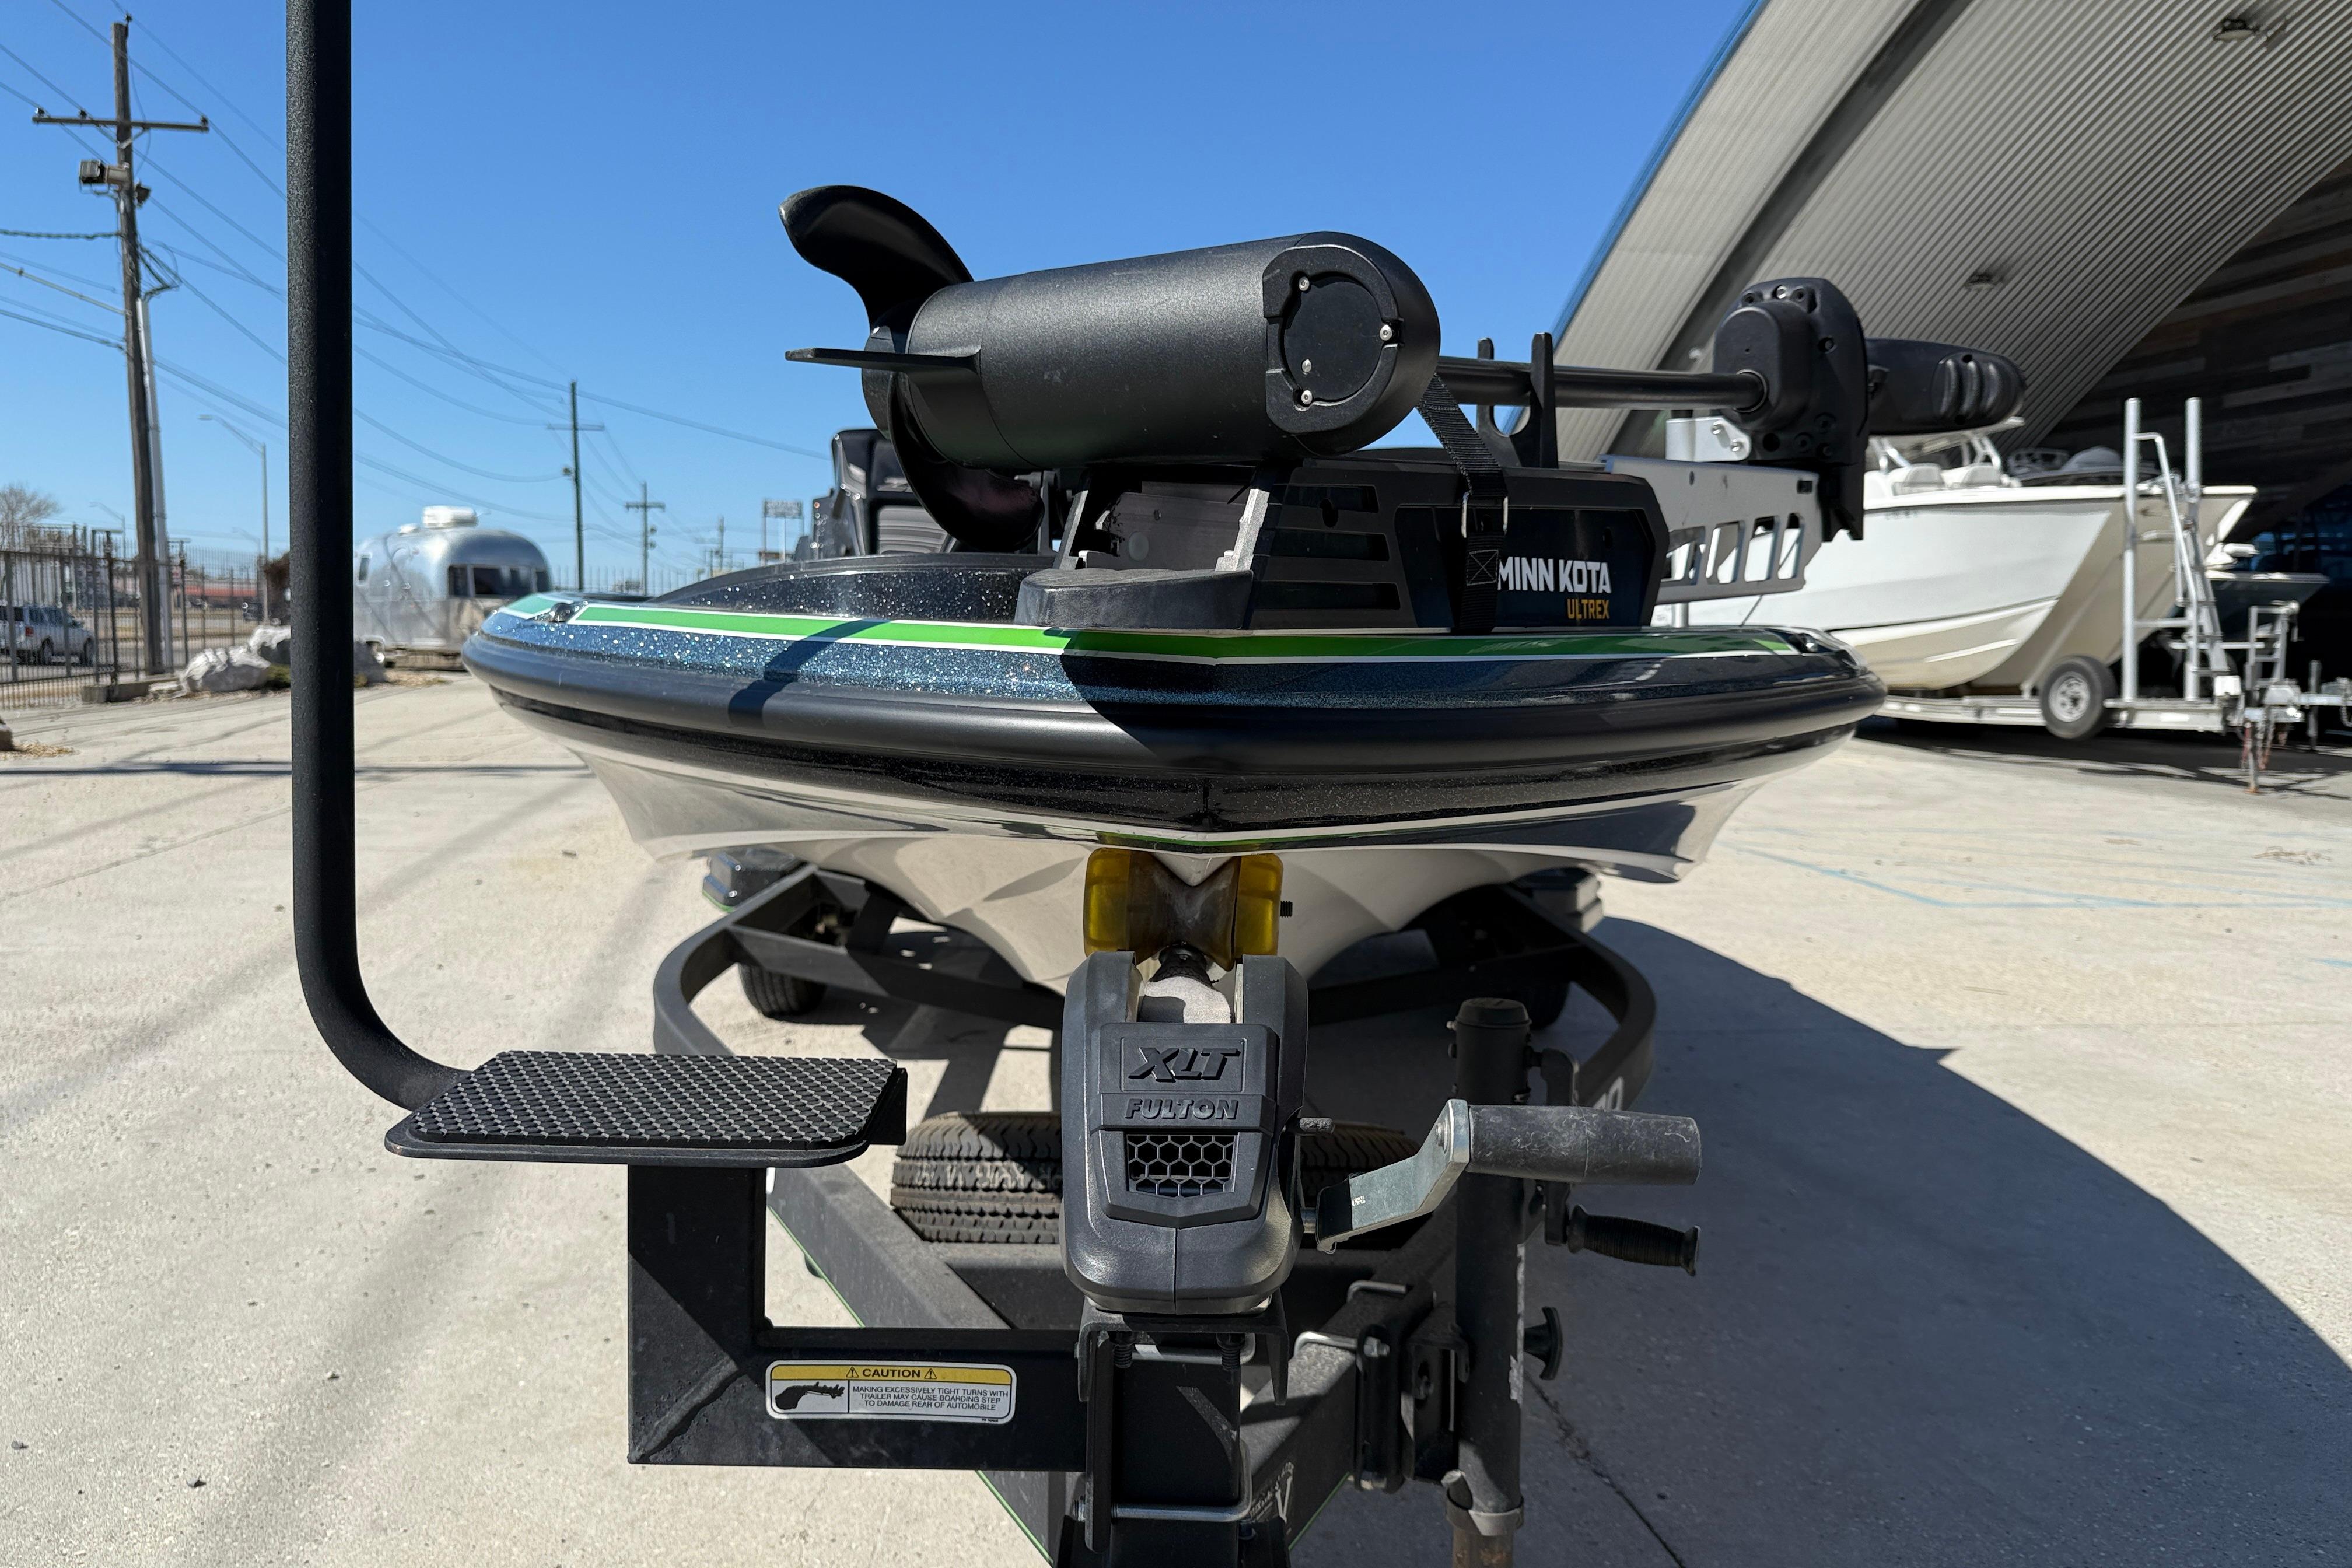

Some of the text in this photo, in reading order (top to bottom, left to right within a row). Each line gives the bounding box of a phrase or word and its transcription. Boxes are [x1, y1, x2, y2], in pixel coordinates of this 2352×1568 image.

[1497, 556, 1612, 594] MINN KOTA
[1567, 598, 1610, 620] ULTREX
[1128, 1047, 1241, 1083] XLT
[1125, 1098, 1238, 1119] FULTON
[862, 1368, 921, 1378] CAUTION
[939, 1395, 979, 1403] BOARDING
[946, 1402, 996, 1410] AUTOMOBILE
